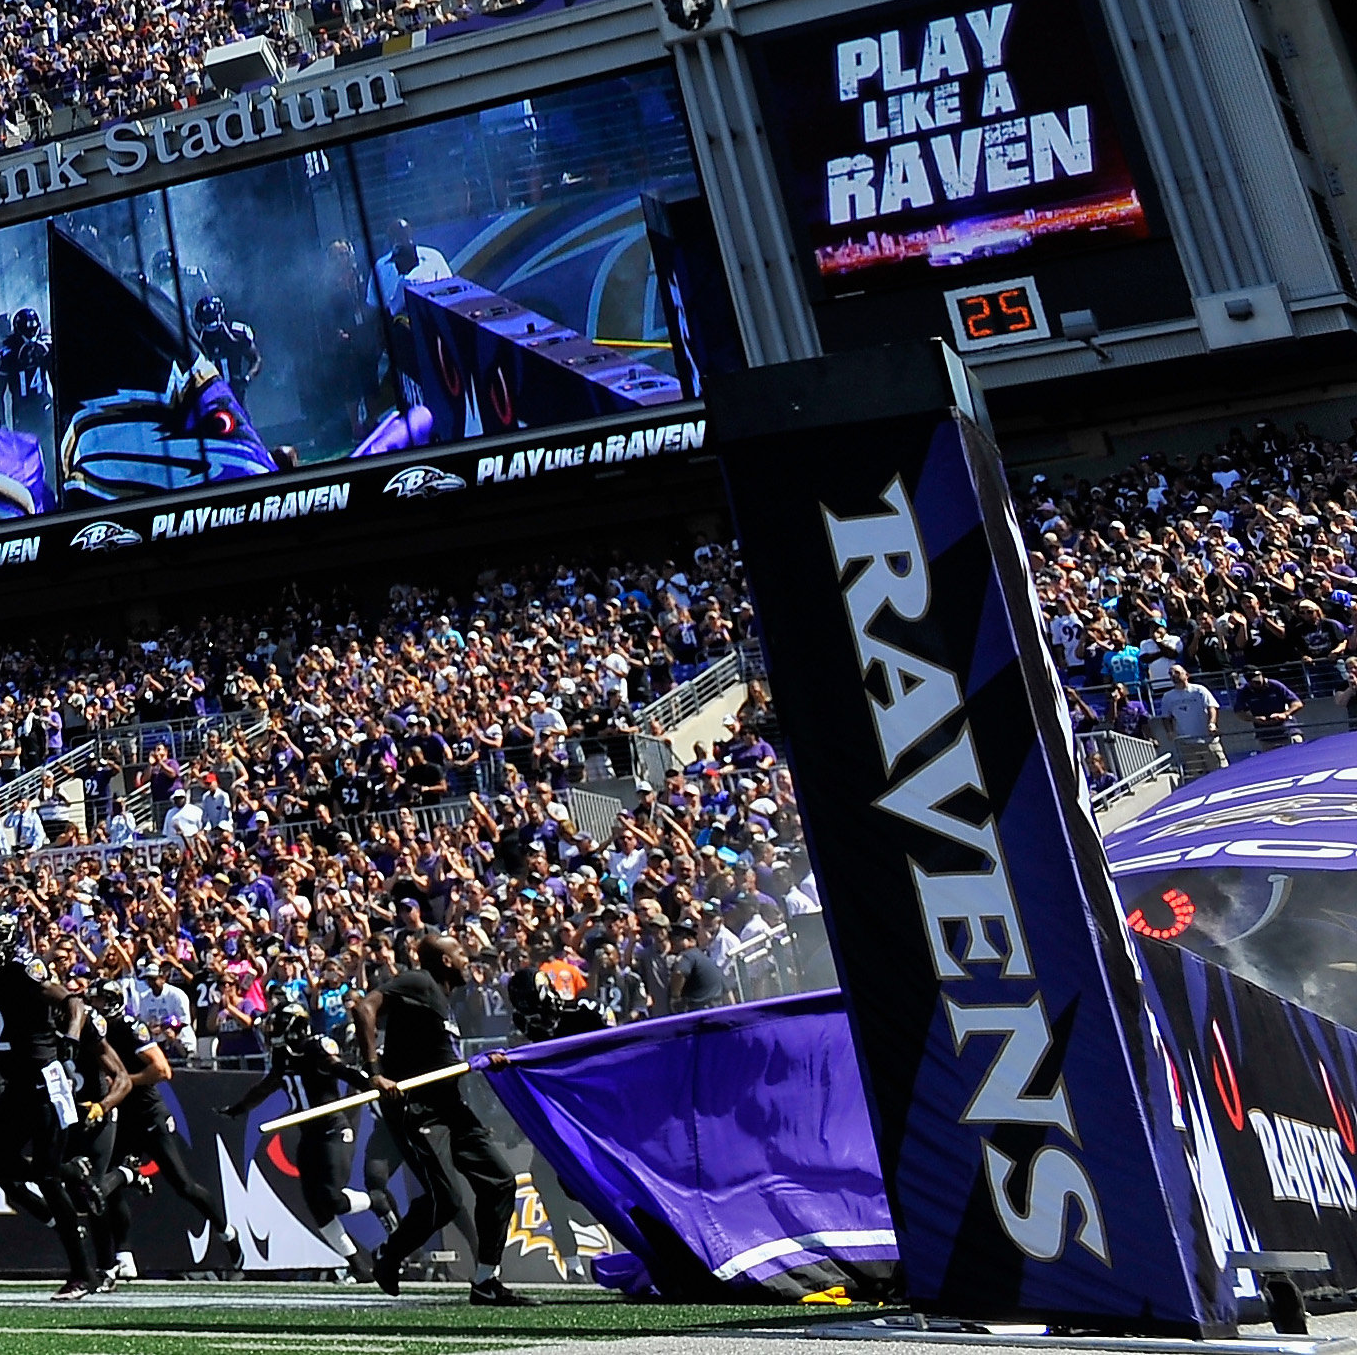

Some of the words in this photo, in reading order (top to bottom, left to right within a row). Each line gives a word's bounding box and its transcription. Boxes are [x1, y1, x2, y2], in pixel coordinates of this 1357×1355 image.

[837, 3, 1013, 101] PLAY
[103, 70, 405, 177] Stadium
[863, 81, 962, 143] LIKE
[982, 70, 1017, 117] A
[827, 104, 1094, 225] RAVEN
[965, 290, 1032, 338] 25
[477, 447, 545, 486] PLAY
[543, 444, 586, 472] LIKE
[588, 442, 604, 463] A
[605, 420, 707, 465] RAVEN
[151, 506, 212, 542] PLAY
[210, 504, 247, 528] LIKE
[248, 502, 261, 522] A
[262, 482, 351, 523] RAVEN
[819, 471, 1112, 1269] RAVENS
